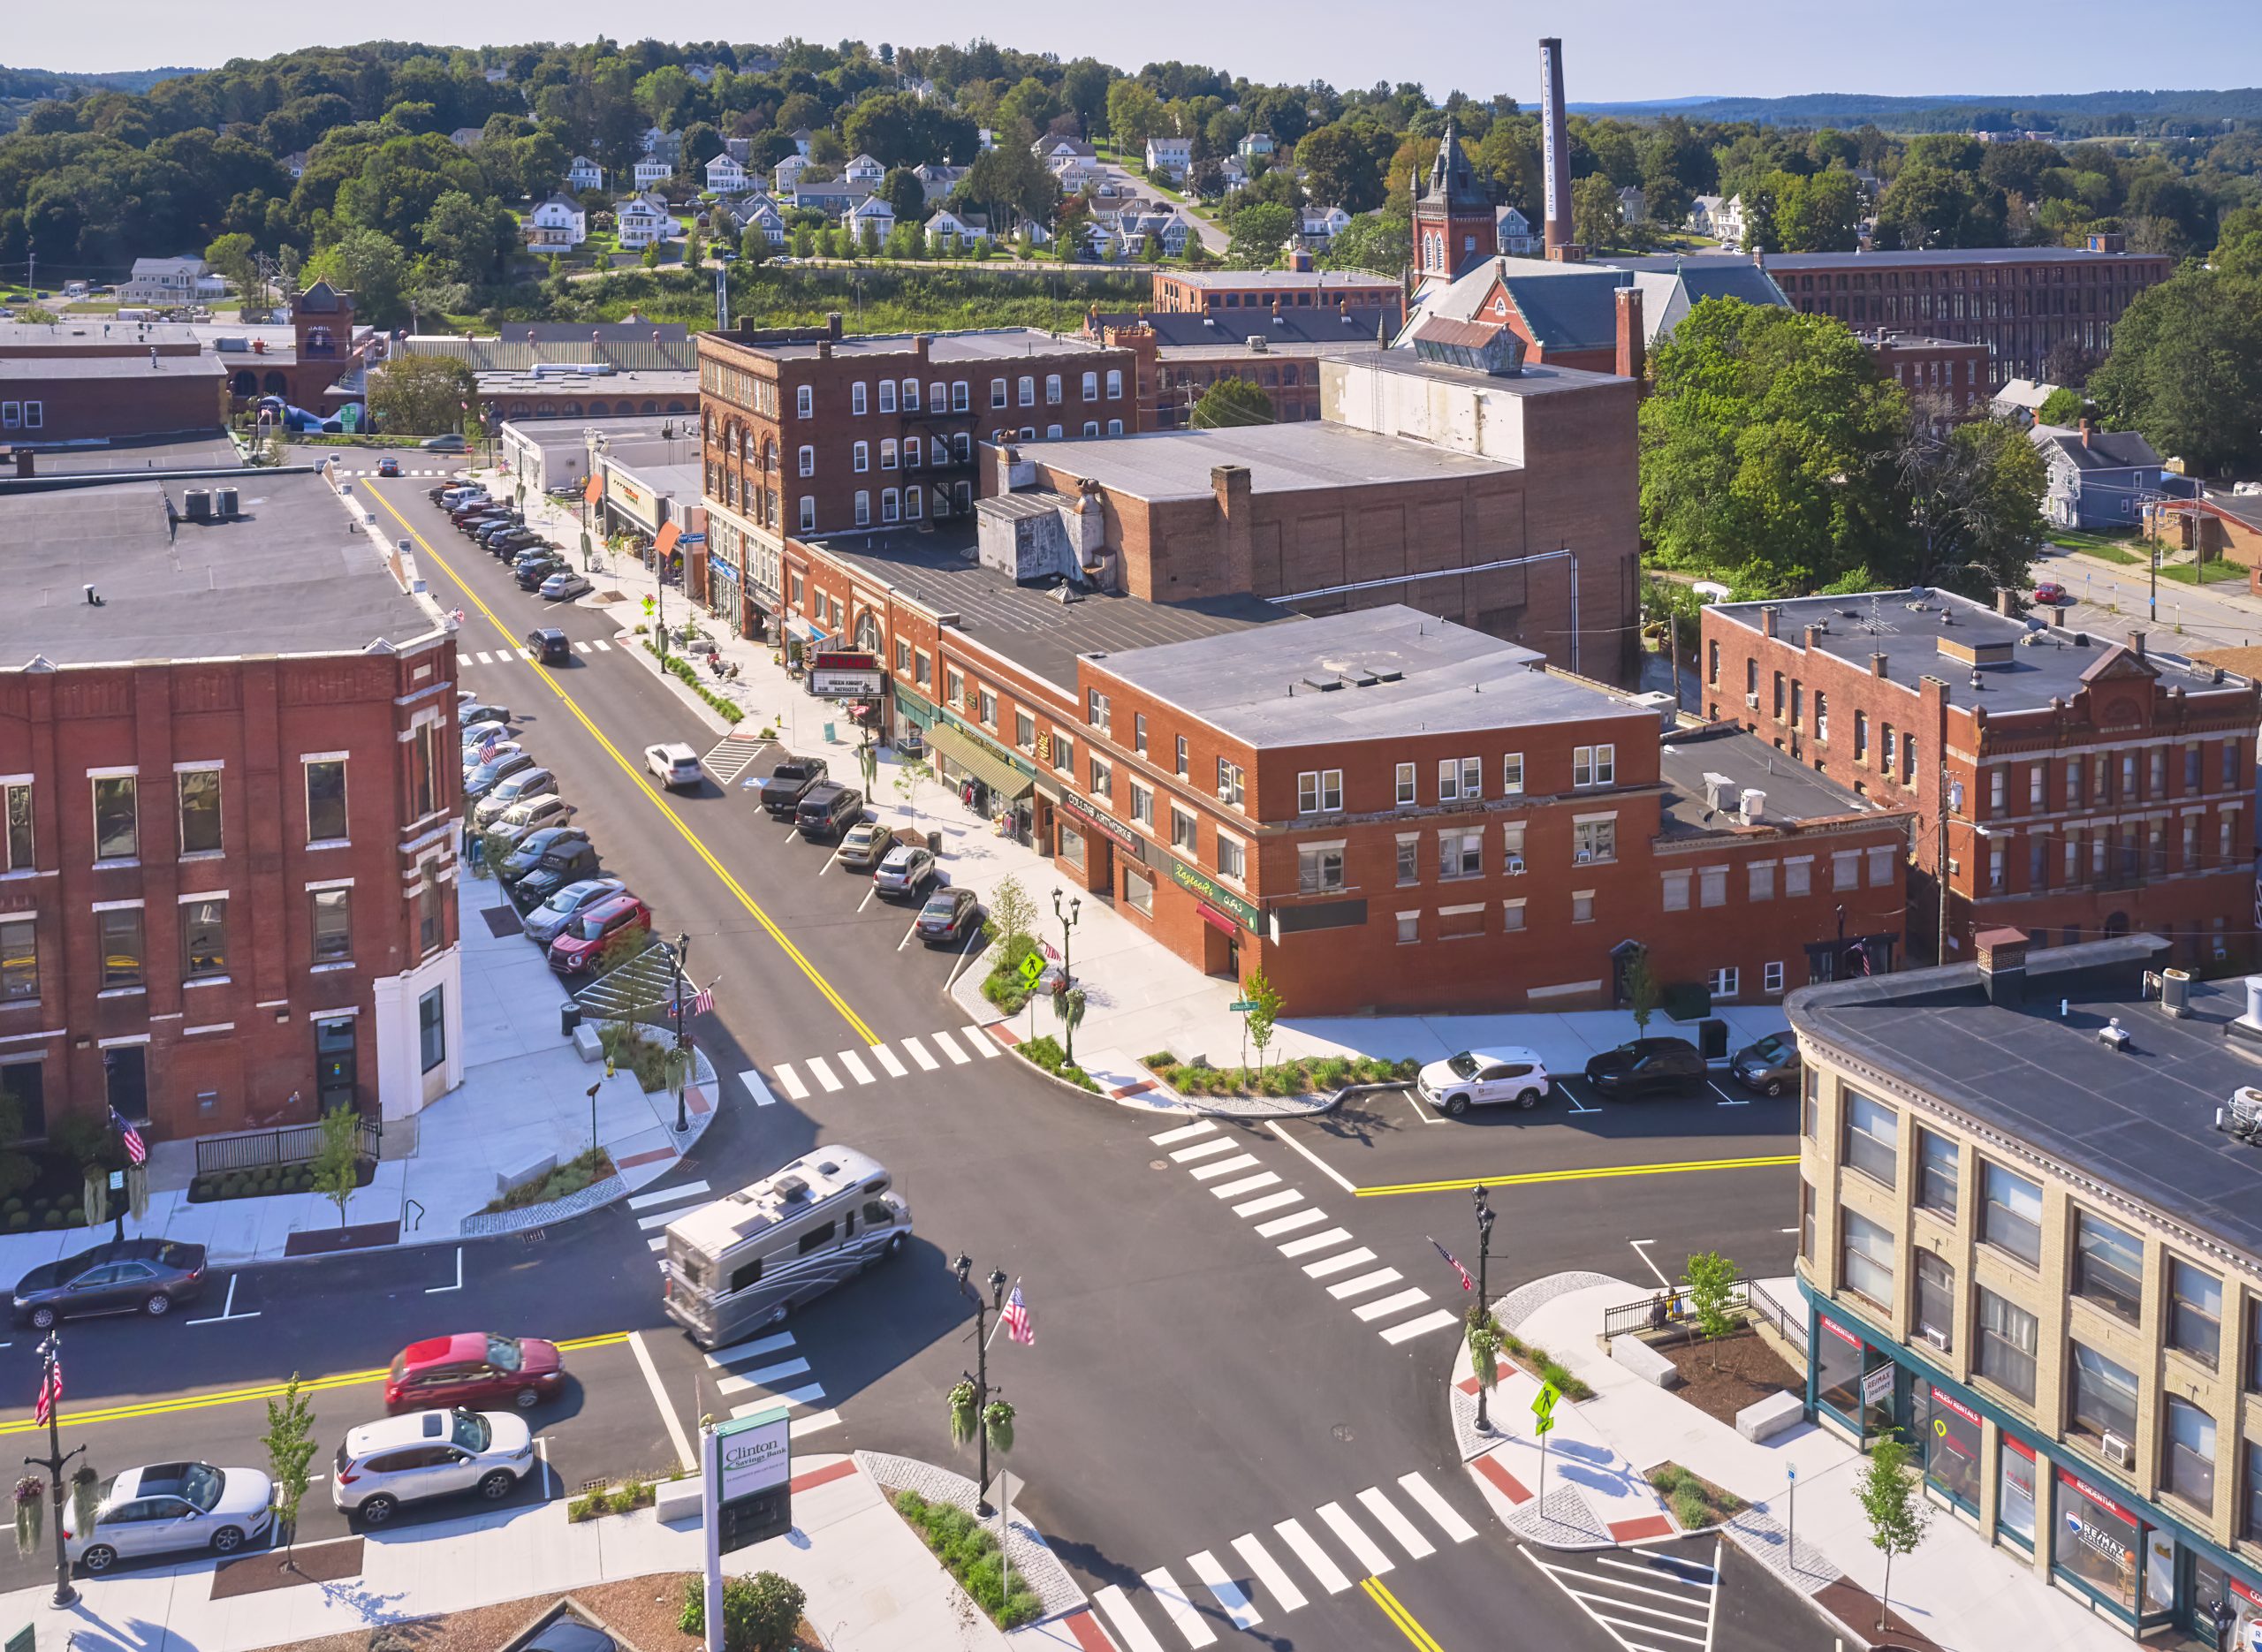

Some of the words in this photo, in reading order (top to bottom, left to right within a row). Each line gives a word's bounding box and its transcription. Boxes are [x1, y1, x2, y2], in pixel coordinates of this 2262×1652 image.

[819, 656, 871, 668] STRAND
[1067, 793, 1095, 817] COLLINS
[1096, 812, 1132, 842] ARTWORKS
[1825, 1316, 1856, 1343] RESIDENTIAL
[1867, 1371, 1891, 1390] RE/MAX
[725, 1440, 778, 1463] Clinton
[735, 1455, 765, 1466] Savings
[767, 1446, 787, 1458] Bank
[2076, 1478, 2117, 1512] RESIDENTIAL
[2084, 1523, 2125, 1557] RE/MAX
[2084, 1532, 2126, 1563] COLLECTION
